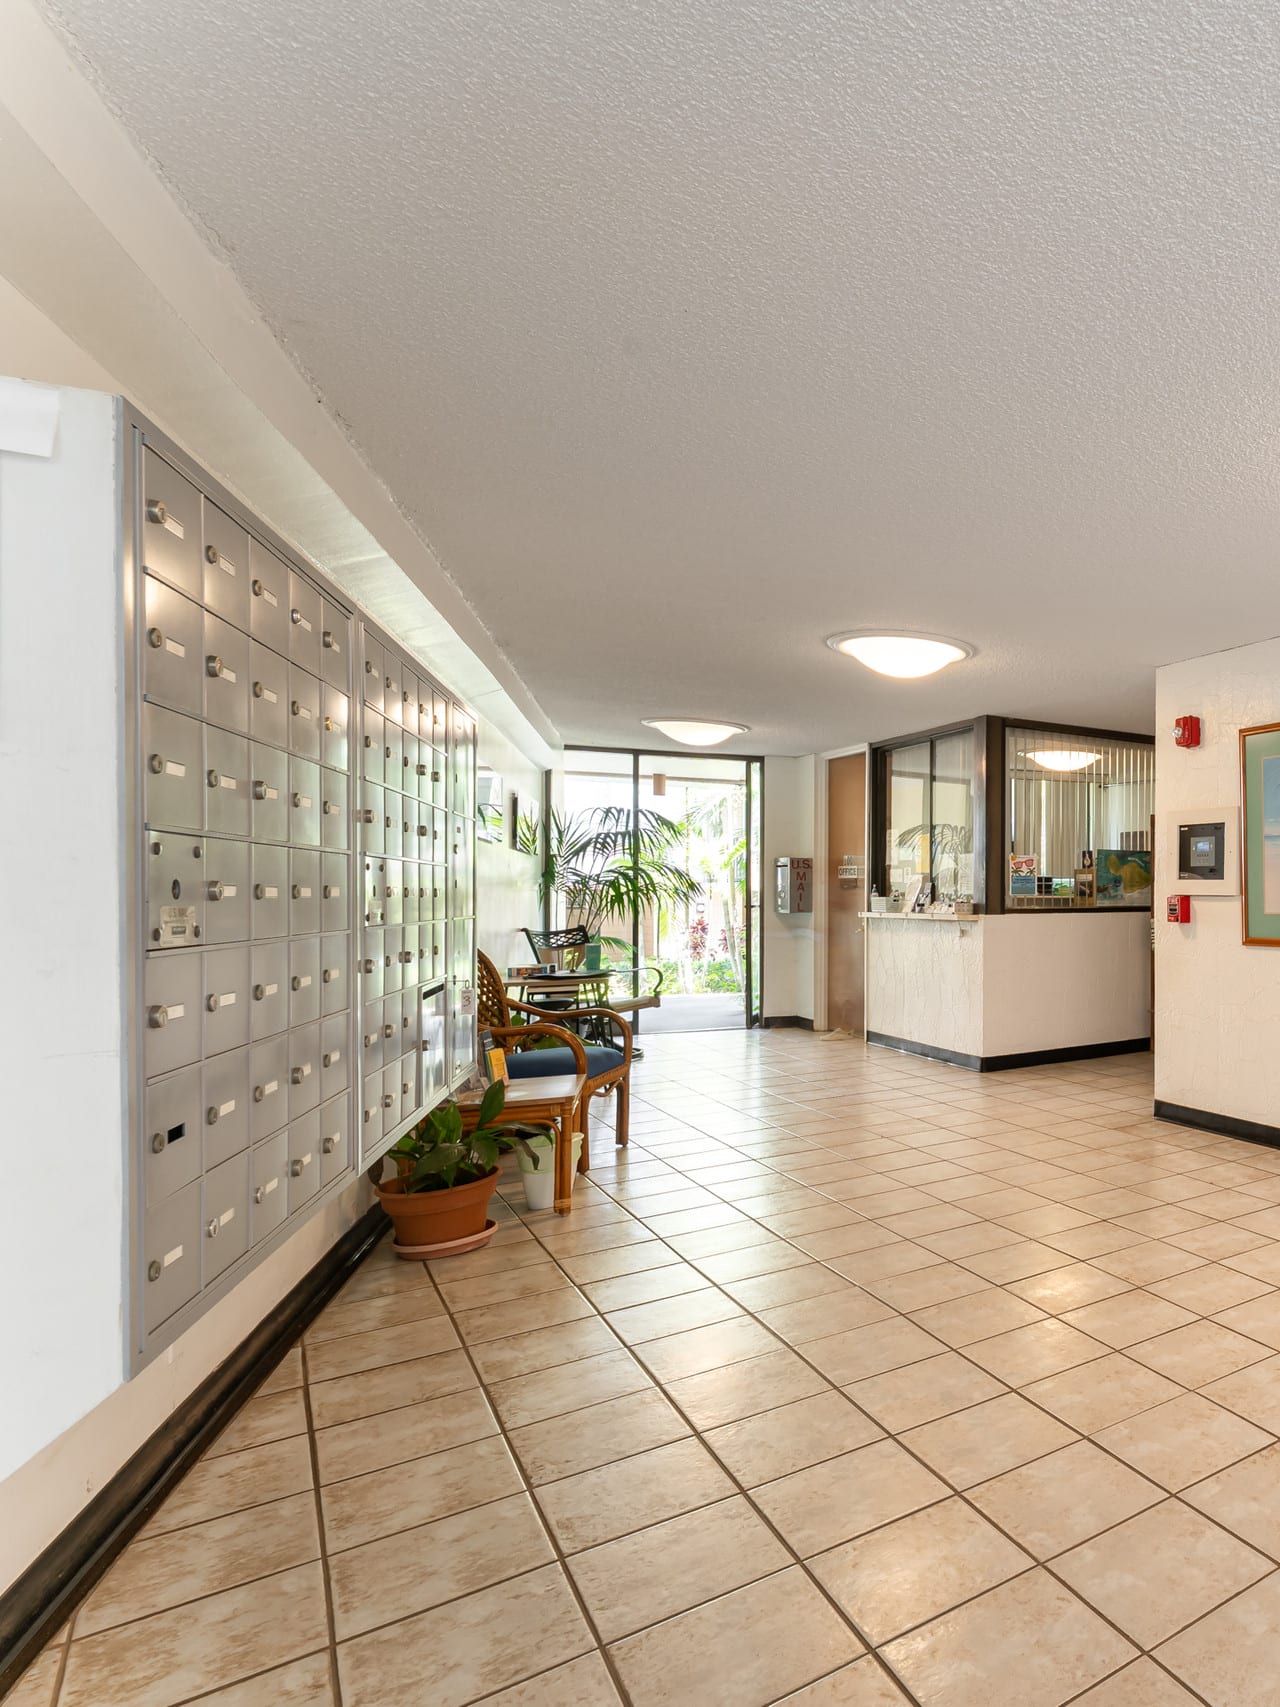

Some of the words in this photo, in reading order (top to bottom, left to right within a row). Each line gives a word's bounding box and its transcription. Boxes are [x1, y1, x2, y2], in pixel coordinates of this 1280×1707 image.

[839, 867, 857, 876] OFFICE
[796, 871, 807, 912] MAIL
[463, 995, 471, 1008] 3
